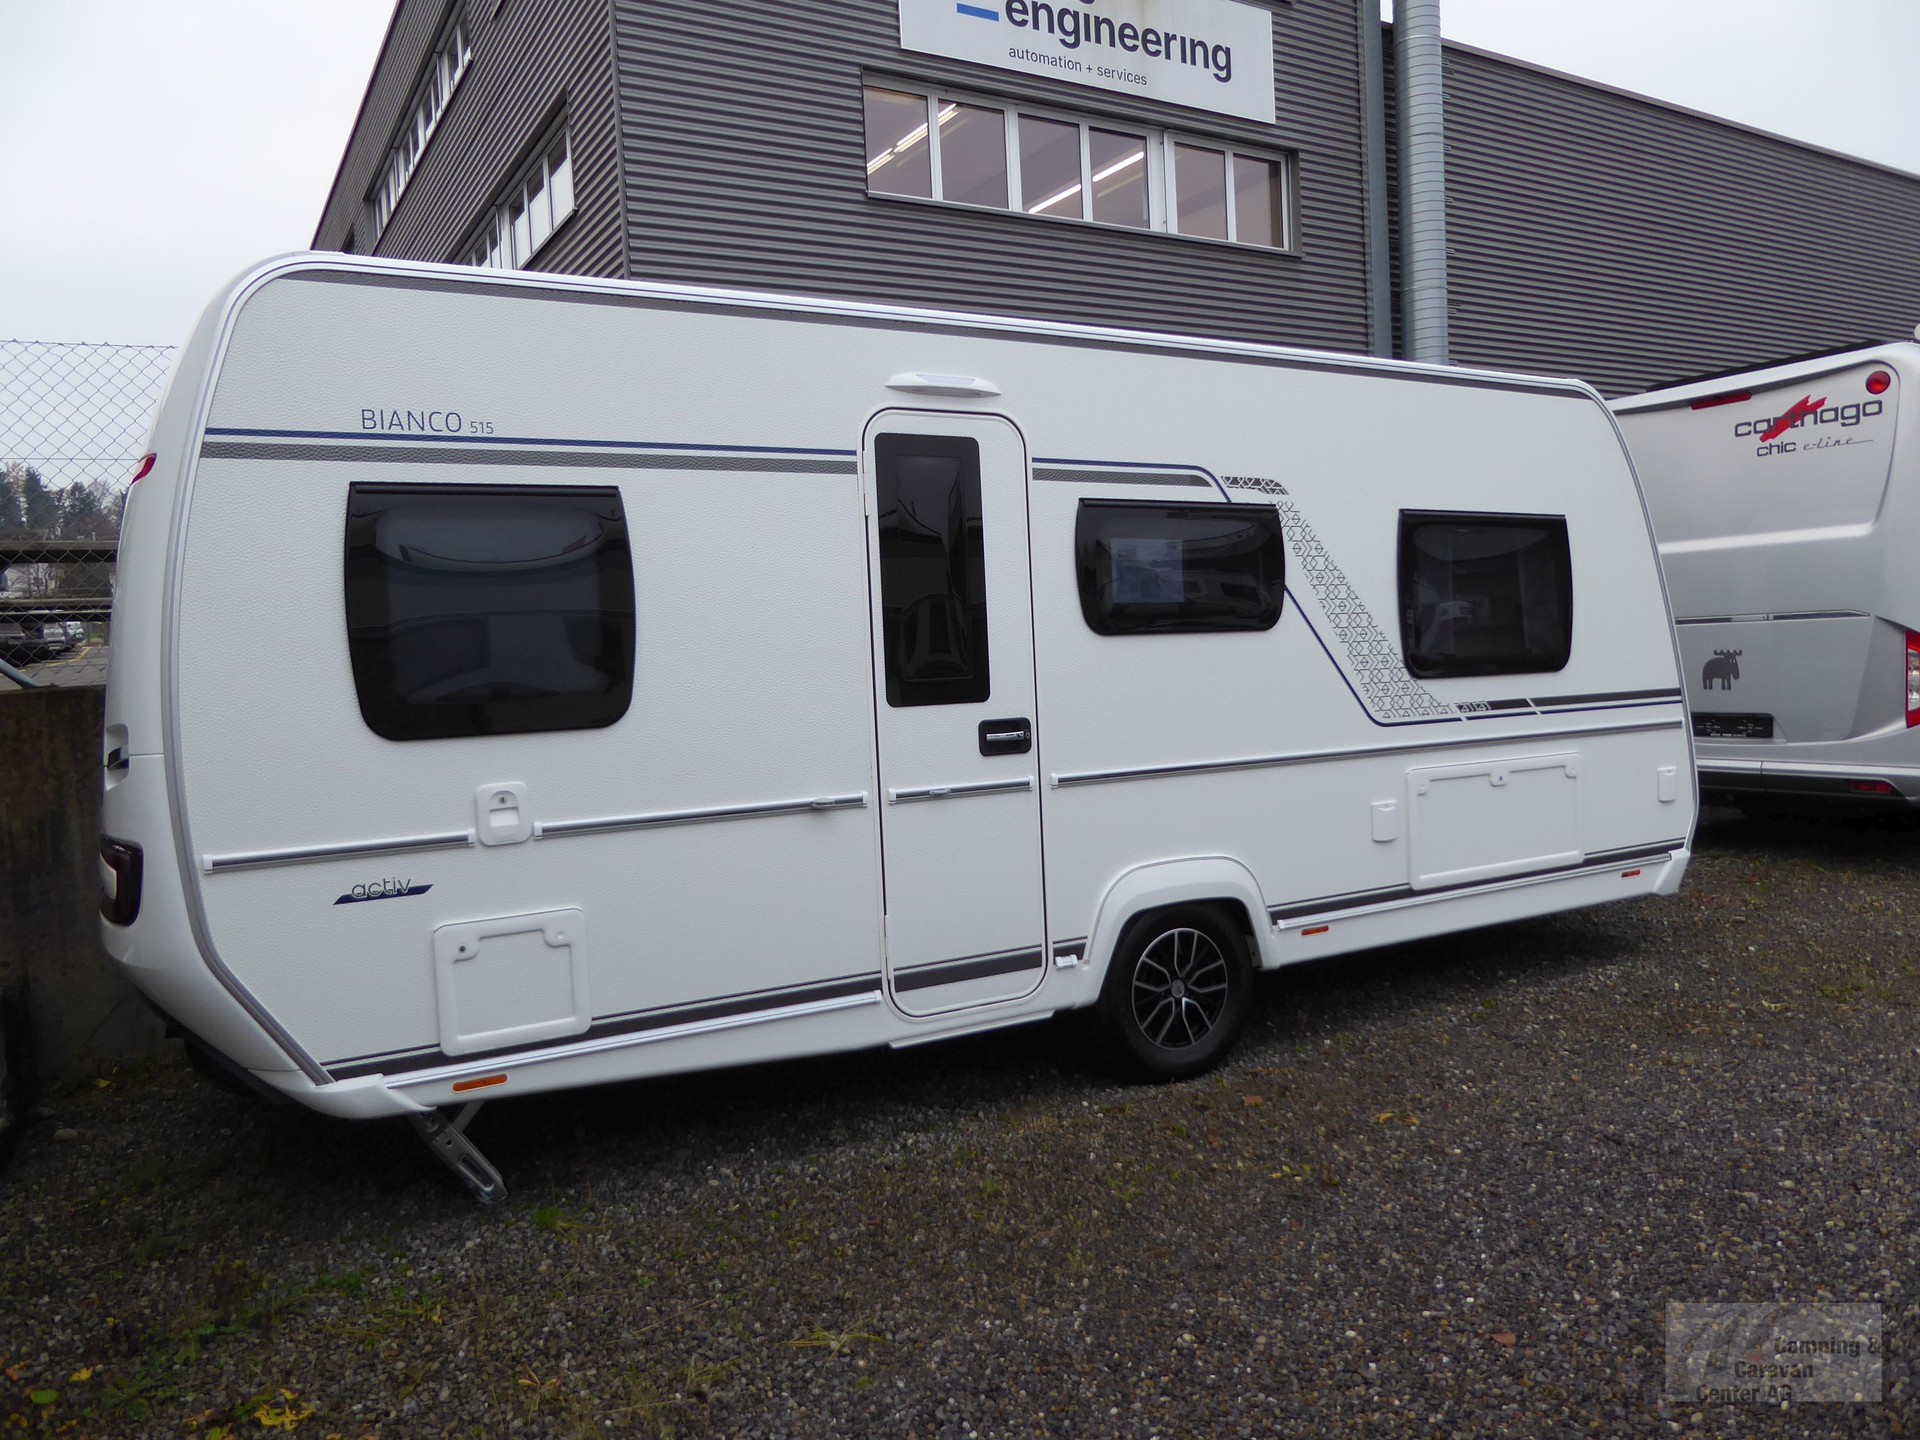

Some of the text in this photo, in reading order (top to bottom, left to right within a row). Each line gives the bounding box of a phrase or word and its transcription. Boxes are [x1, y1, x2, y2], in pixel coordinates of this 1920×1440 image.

[1005, 0, 1232, 82] engineering
[1008, 47, 1082, 72] automation
[1097, 65, 1147, 85] services
[361, 409, 494, 434] BIANCO 515
[1734, 399, 1882, 438] carthago
[1757, 441, 1797, 457] chic
[351, 877, 411, 898] activ
